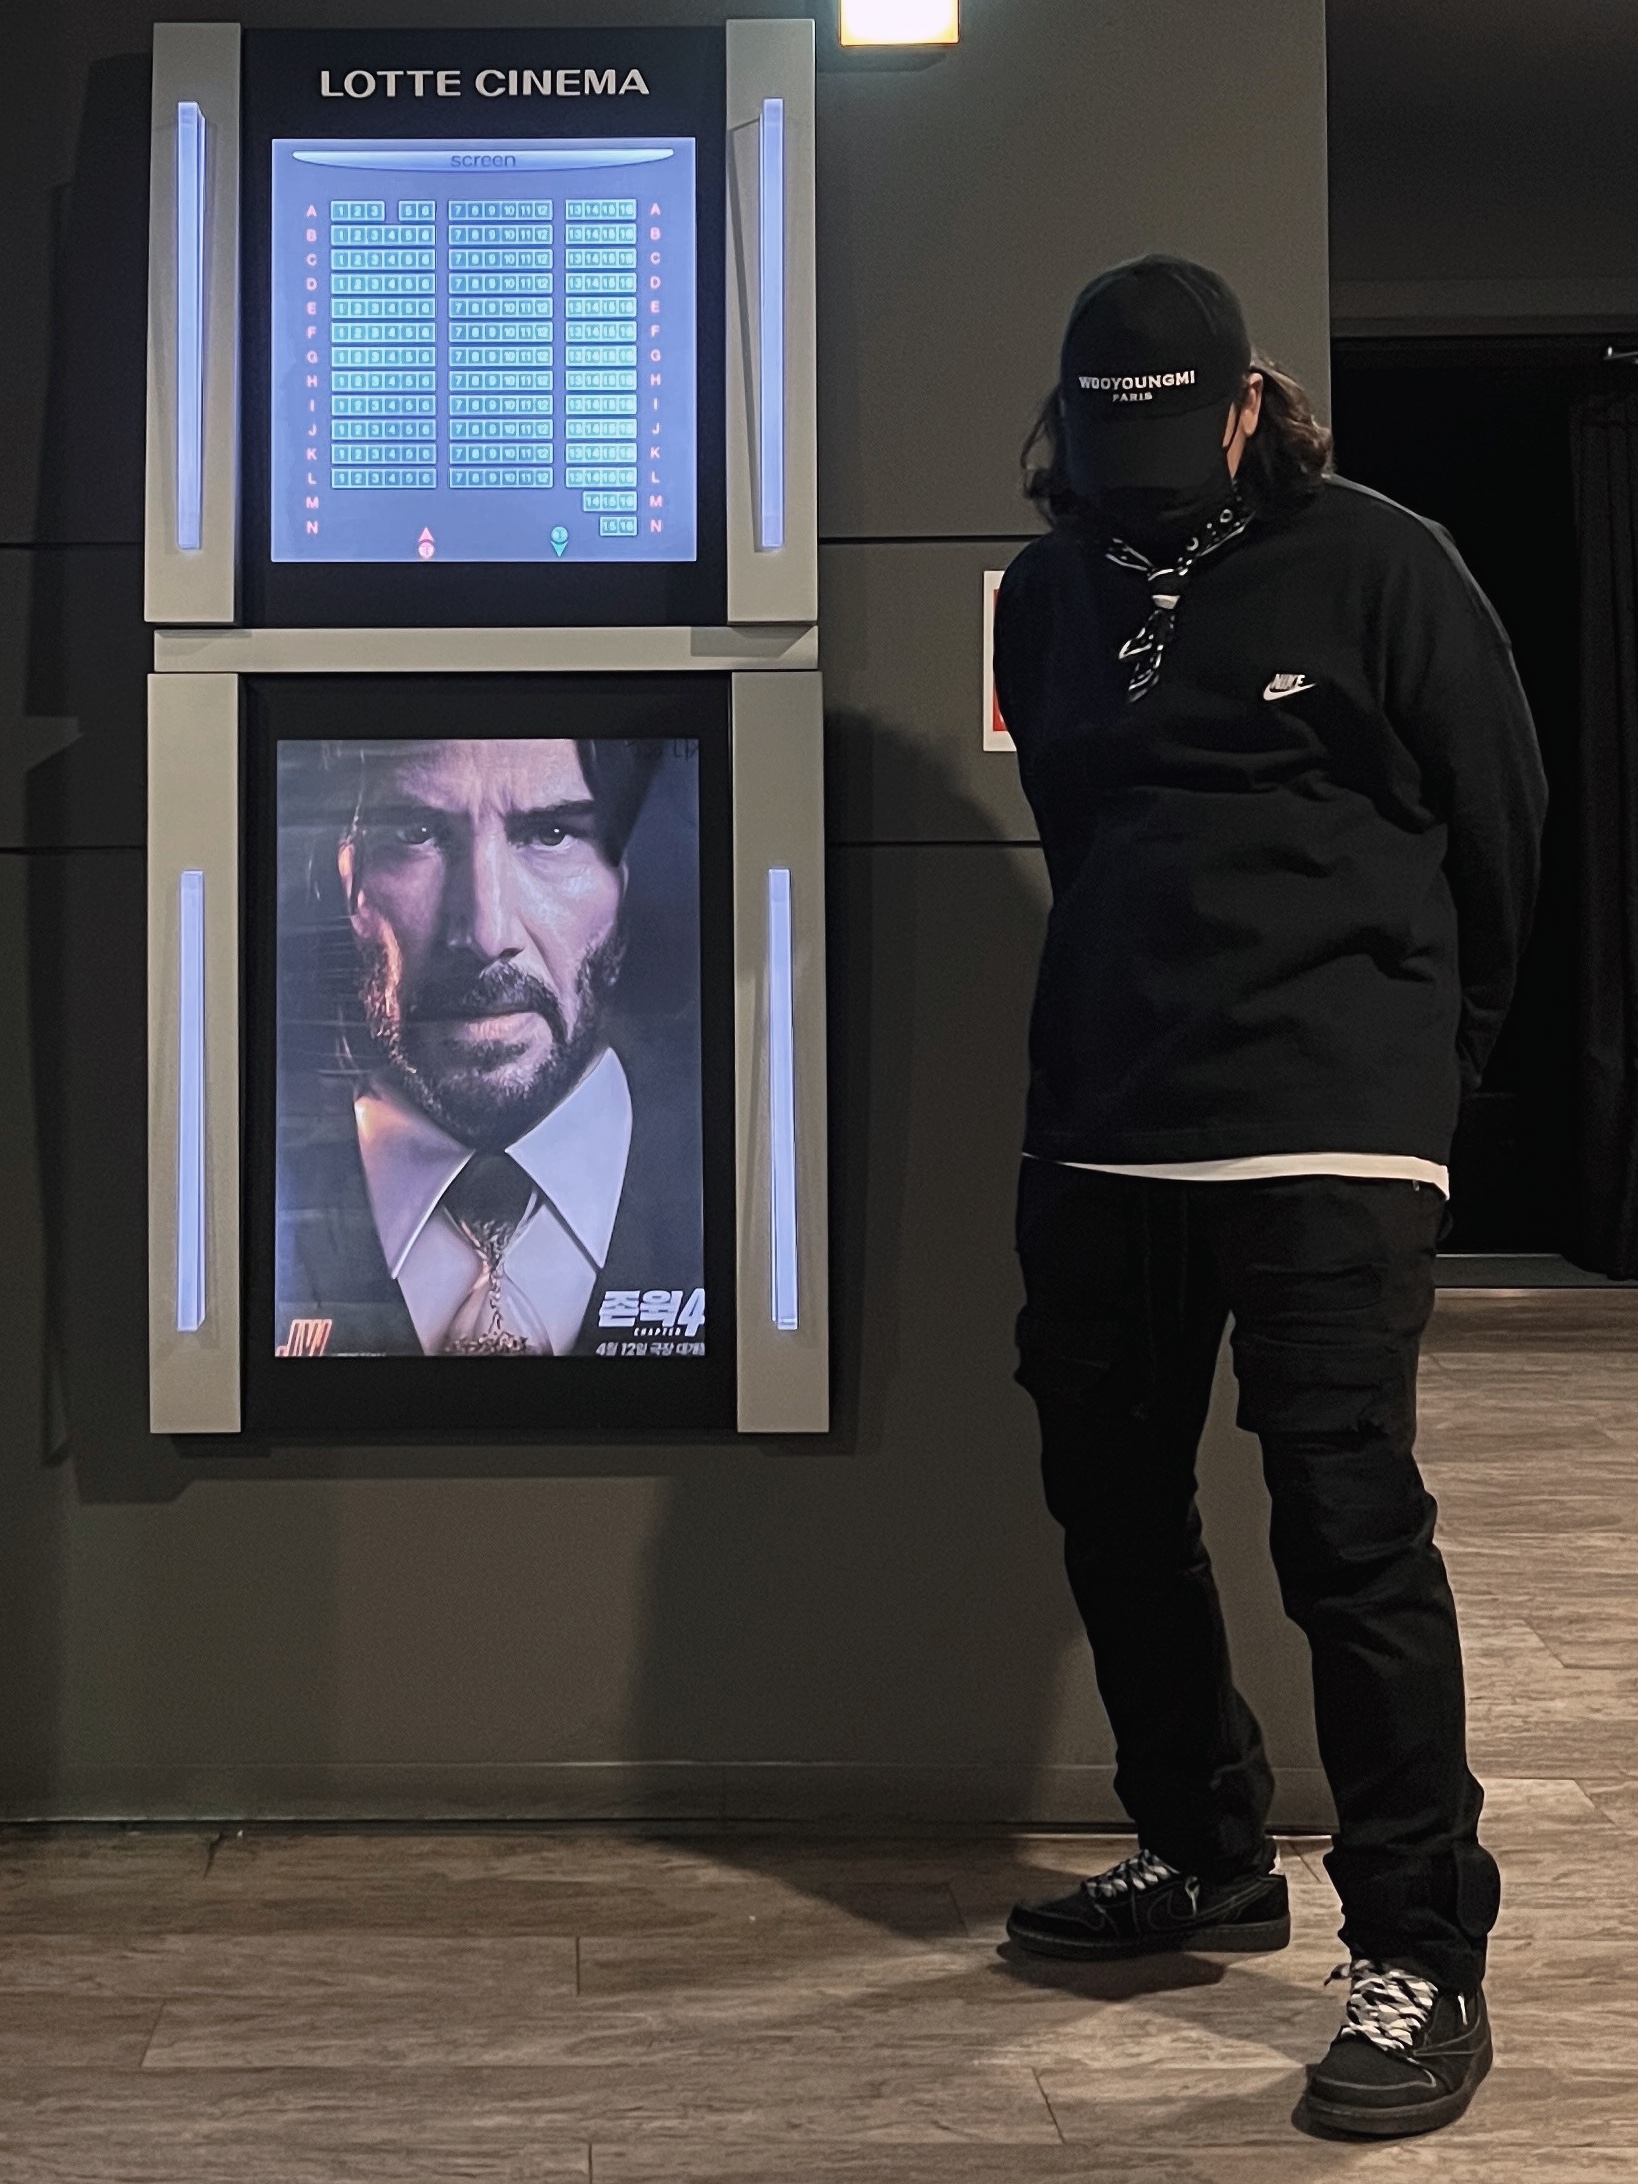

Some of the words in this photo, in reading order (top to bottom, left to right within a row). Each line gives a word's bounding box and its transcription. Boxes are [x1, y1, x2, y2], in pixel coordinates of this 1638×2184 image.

[321, 70, 461, 98] LOTTE
[475, 68, 650, 97] CINEMA
[450, 153, 516, 168] screen
[307, 205, 317, 217] A
[650, 203, 661, 216] A
[307, 229, 317, 242] B
[650, 227, 661, 240] B
[306, 254, 317, 266] C
[649, 252, 661, 265] C
[306, 278, 317, 291] D
[650, 276, 661, 289] D
[307, 302, 317, 315] E
[650, 301, 660, 313] E
[307, 326, 317, 339] F
[650, 325, 660, 337] F
[306, 351, 318, 364] G
[650, 349, 661, 362] G
[306, 376, 318, 388] H
[650, 373, 662, 386] H
[1079, 369, 1195, 391] WOOYOUNGMI
[1112, 391, 1153, 402] PARIS
[308, 424, 317, 436] J
[651, 422, 660, 435] J
[306, 448, 317, 460] K
[650, 447, 661, 459] K
[307, 473, 317, 485] L
[650, 471, 660, 484] L
[306, 496, 319, 509] M
[649, 495, 663, 508] M
[306, 521, 319, 534] N
[650, 520, 662, 533] N
[1270, 673, 1306, 690] NIKE
[596, 1342, 619, 1356] 4월
[621, 1342, 648, 1356] 12일
